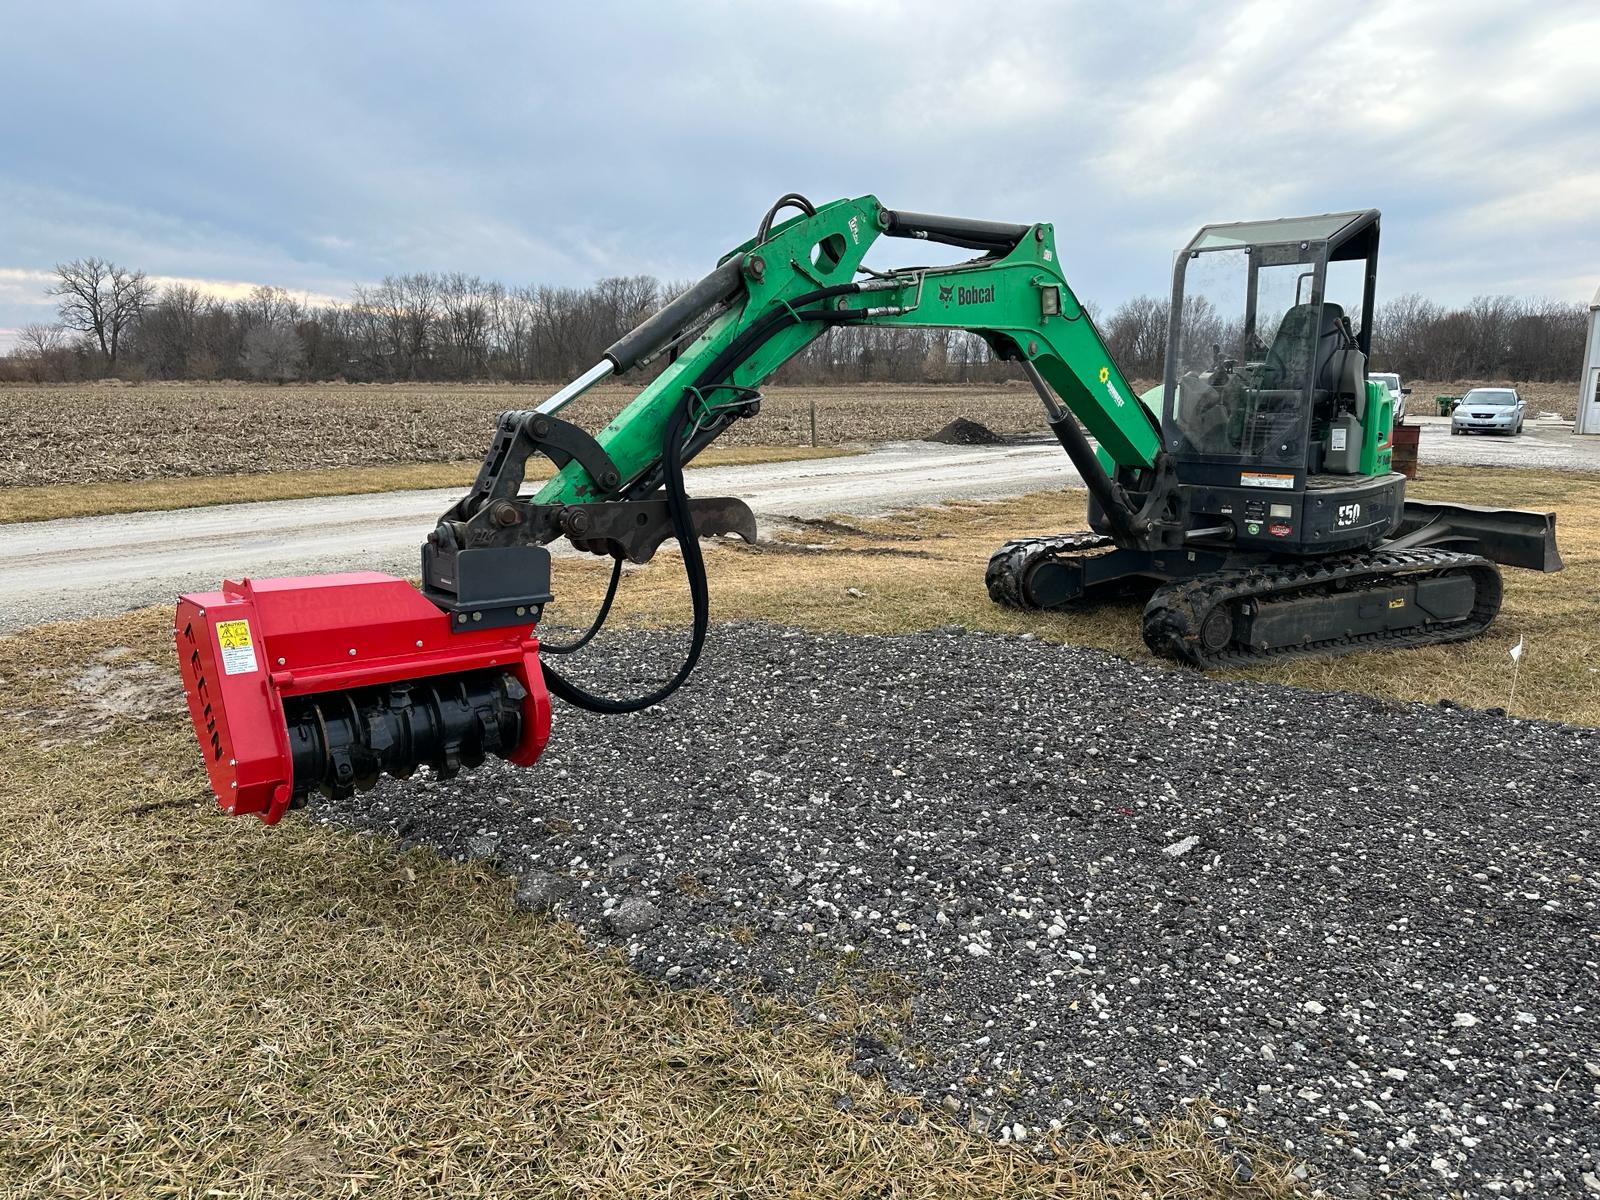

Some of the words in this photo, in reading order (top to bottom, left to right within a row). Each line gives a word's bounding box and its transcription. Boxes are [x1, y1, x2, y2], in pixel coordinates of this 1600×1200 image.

[958, 284, 995, 305] Bobcat
[1338, 503, 1360, 526] E50
[184, 622, 223, 761] FECON
